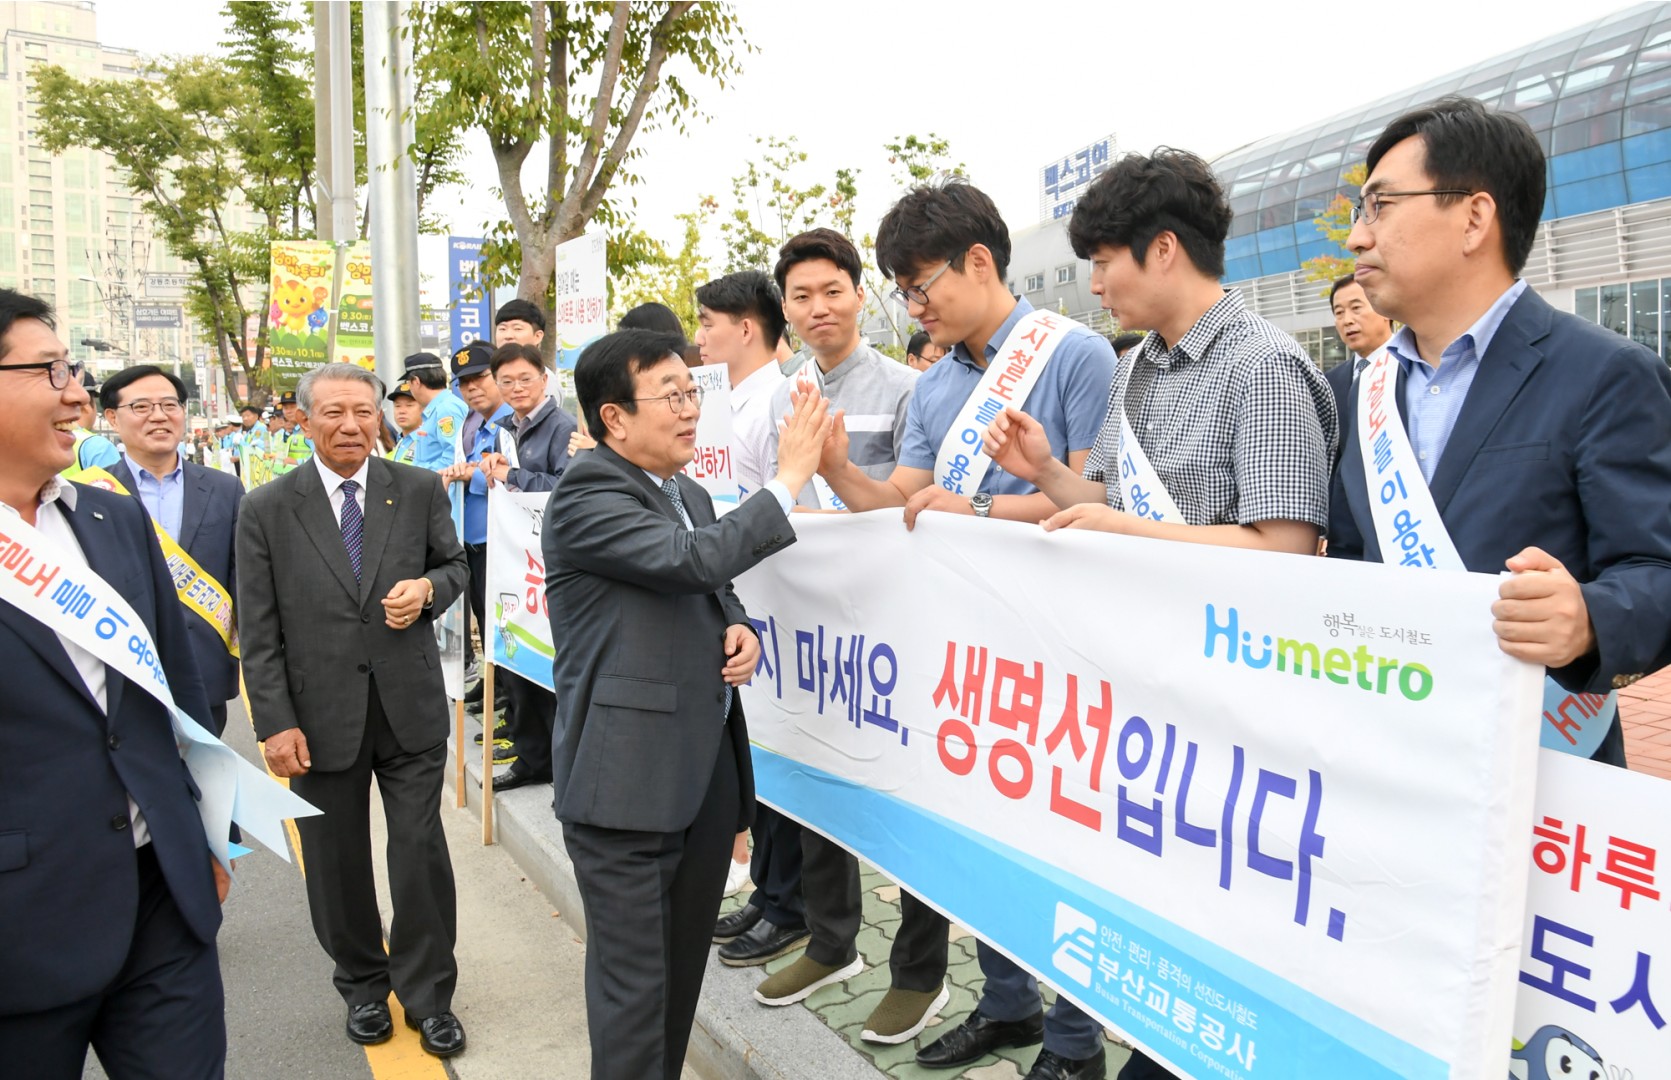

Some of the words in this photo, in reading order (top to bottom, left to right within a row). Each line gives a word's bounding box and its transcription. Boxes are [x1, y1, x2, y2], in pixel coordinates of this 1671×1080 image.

[1044, 140, 1108, 200] 벡스코역
[459, 259, 481, 348] 벡스코역
[693, 446, 731, 480] 안하기
[1122, 452, 1164, 521] 이용
[1379, 626, 1433, 646] 도시철도
[795, 624, 909, 747] 마세요.
[932, 640, 1346, 942] 생명선입니다.
[1094, 982, 1121, 1007] Busan
[1121, 999, 1188, 1050] Transportation
[1097, 952, 1257, 1072] 부산교통공사
